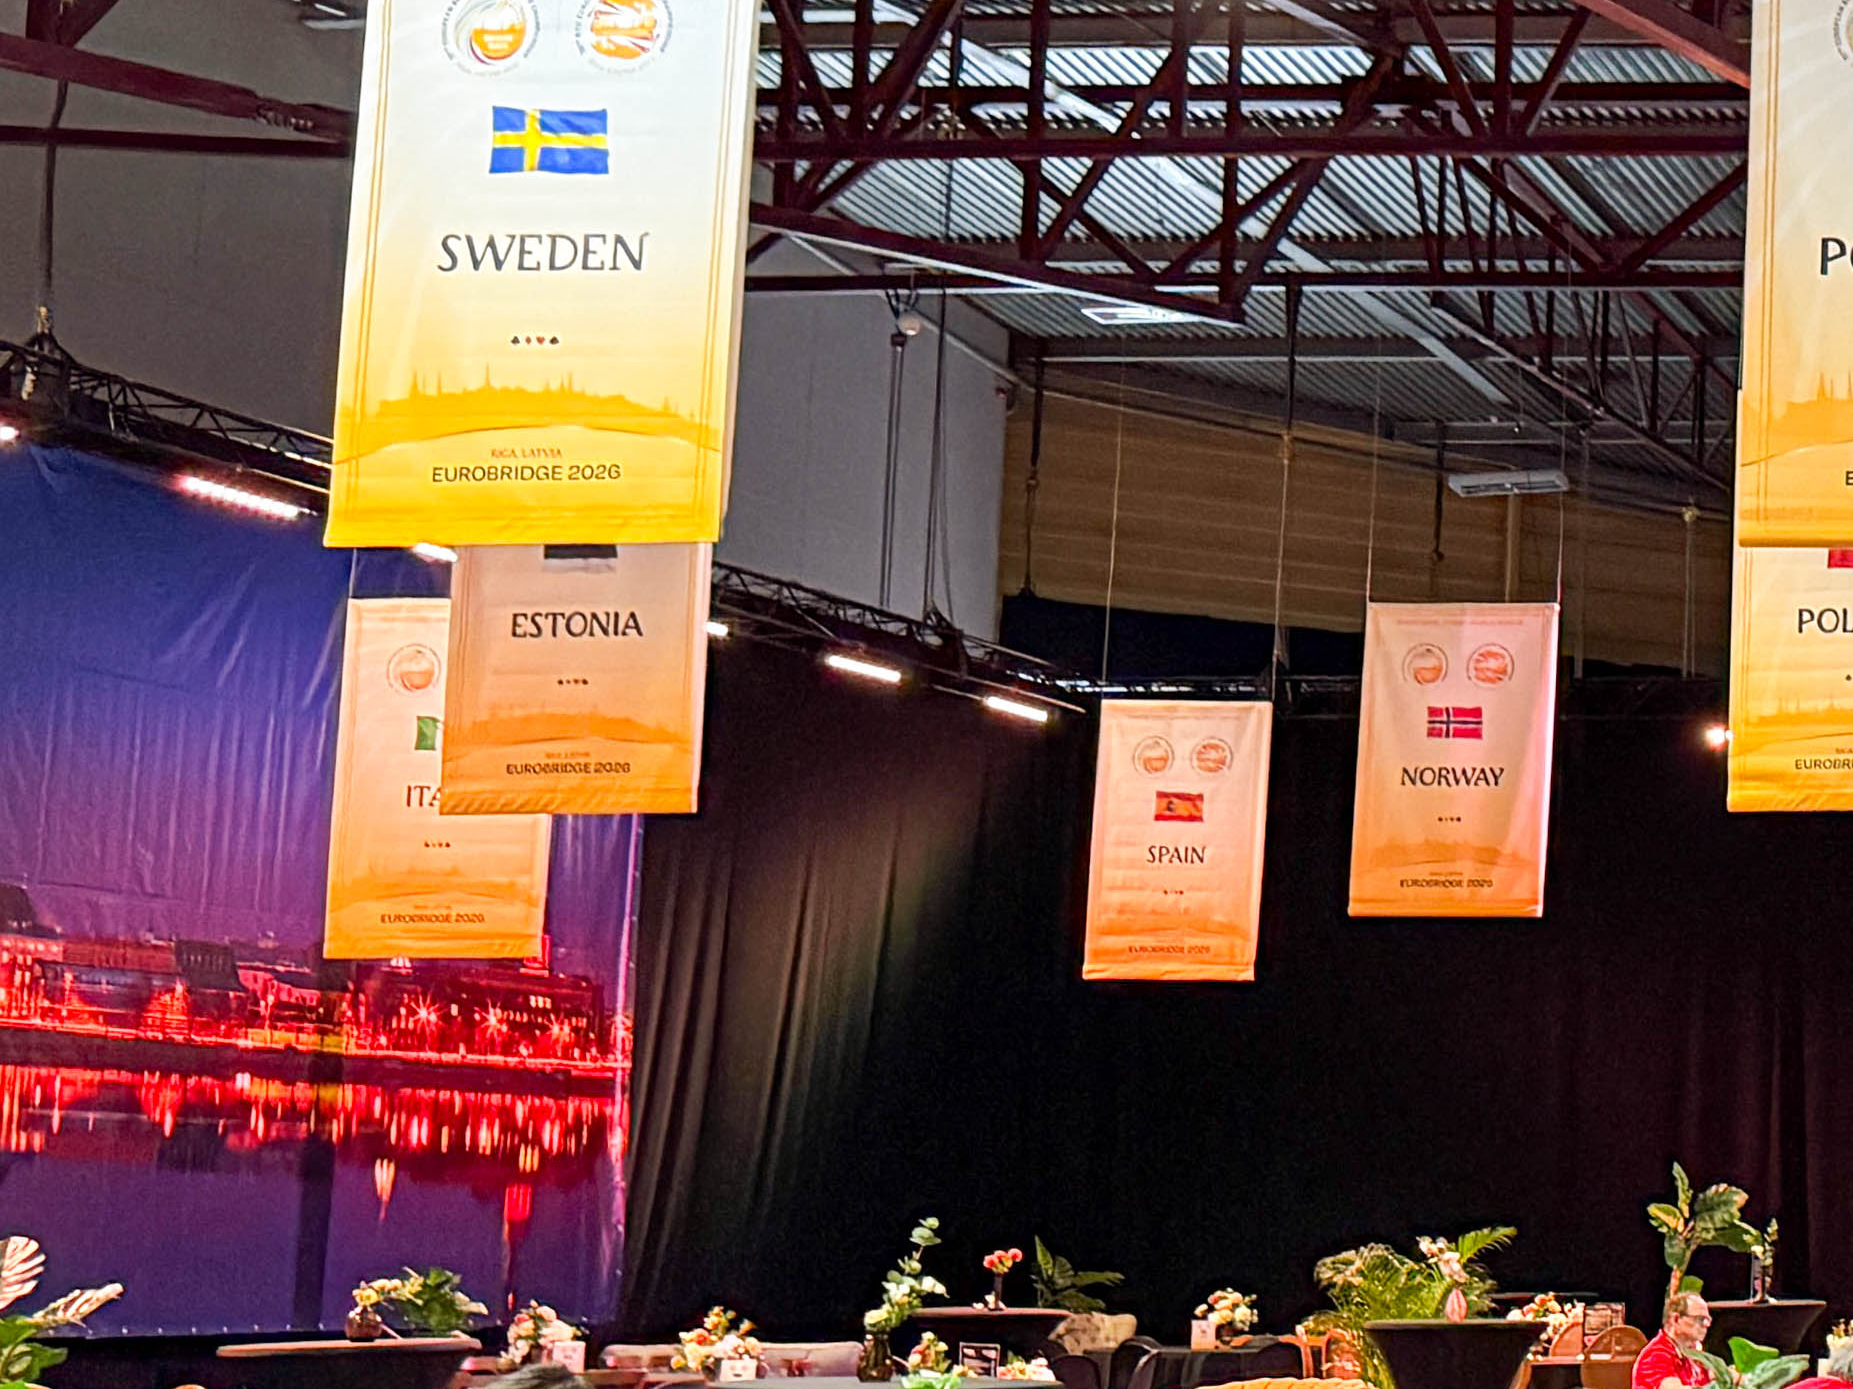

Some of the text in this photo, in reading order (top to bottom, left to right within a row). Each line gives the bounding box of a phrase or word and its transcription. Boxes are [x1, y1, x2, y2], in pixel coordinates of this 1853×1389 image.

[436, 231, 652, 272] SWEDEN
[522, 447, 563, 459] LATVIA
[431, 463, 622, 484] EUROBRIDGE 2026
[511, 611, 644, 638] ESTONIA
[506, 763, 592, 775] EUROBRIDGE
[1400, 766, 1505, 788] NORWAY
[1146, 845, 1206, 864] SPAIN
